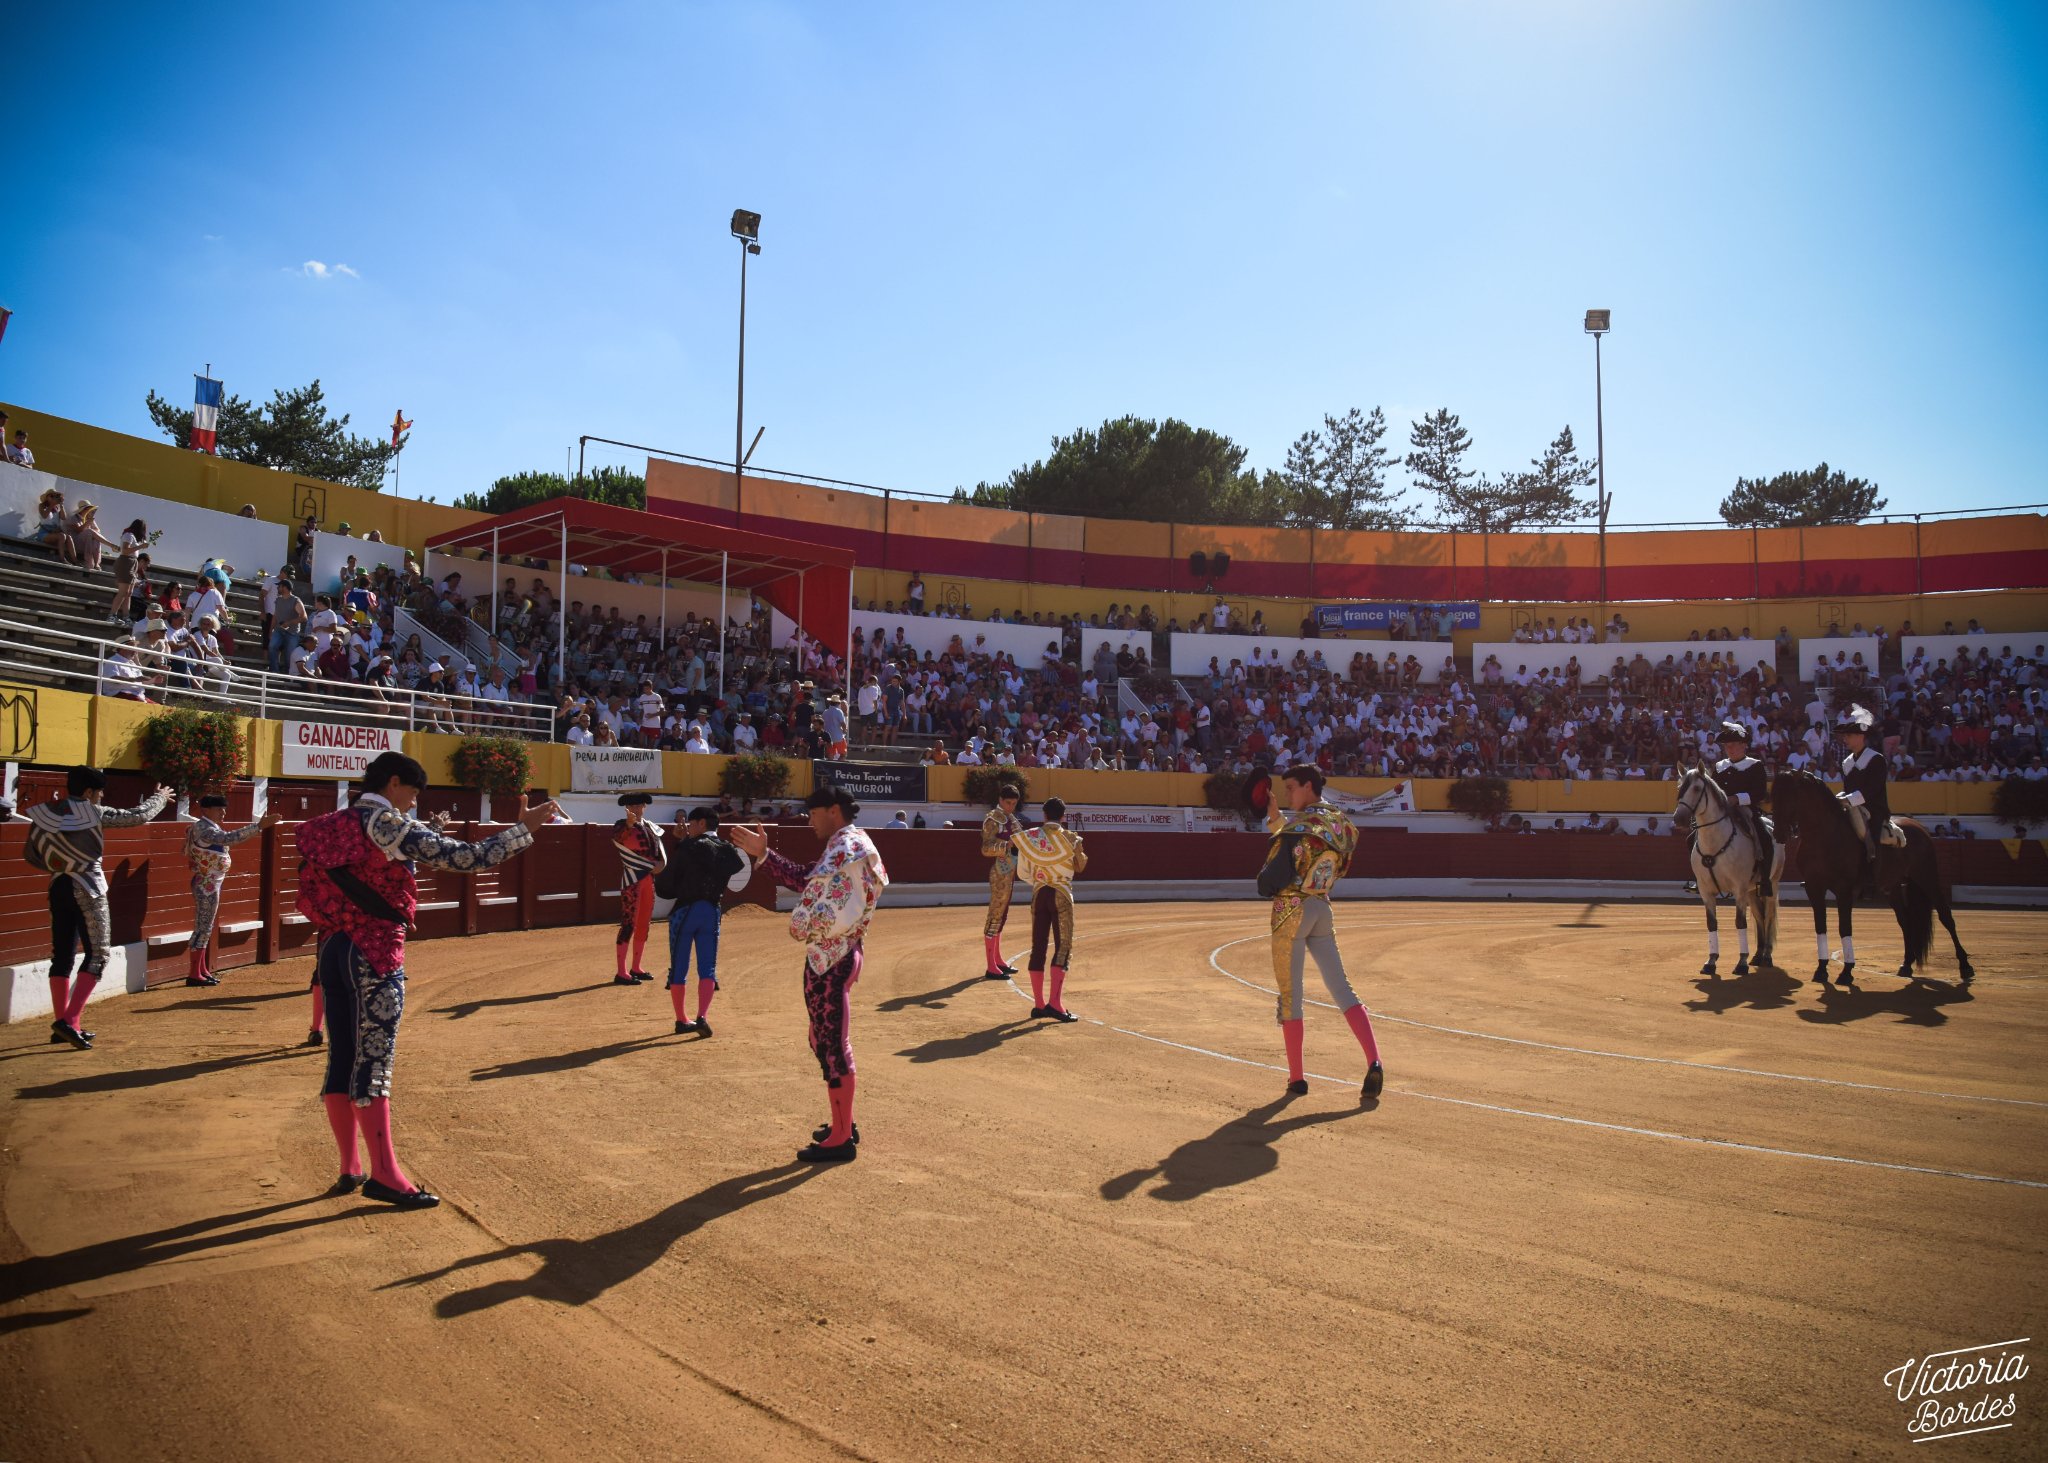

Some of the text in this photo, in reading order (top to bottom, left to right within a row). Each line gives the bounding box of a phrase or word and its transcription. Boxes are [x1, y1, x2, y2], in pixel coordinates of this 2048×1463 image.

[1344, 610, 1384, 620] france
[1388, 609, 1415, 620] ble
[298, 723, 391, 750] GANADERIA
[307, 754, 368, 771] MONTEALTO
[600, 752, 610, 762] LA
[835, 769, 901, 782] Peña Taurine
[844, 783, 893, 794] MUGRON
[1091, 813, 1129, 823] DESCENDRE
